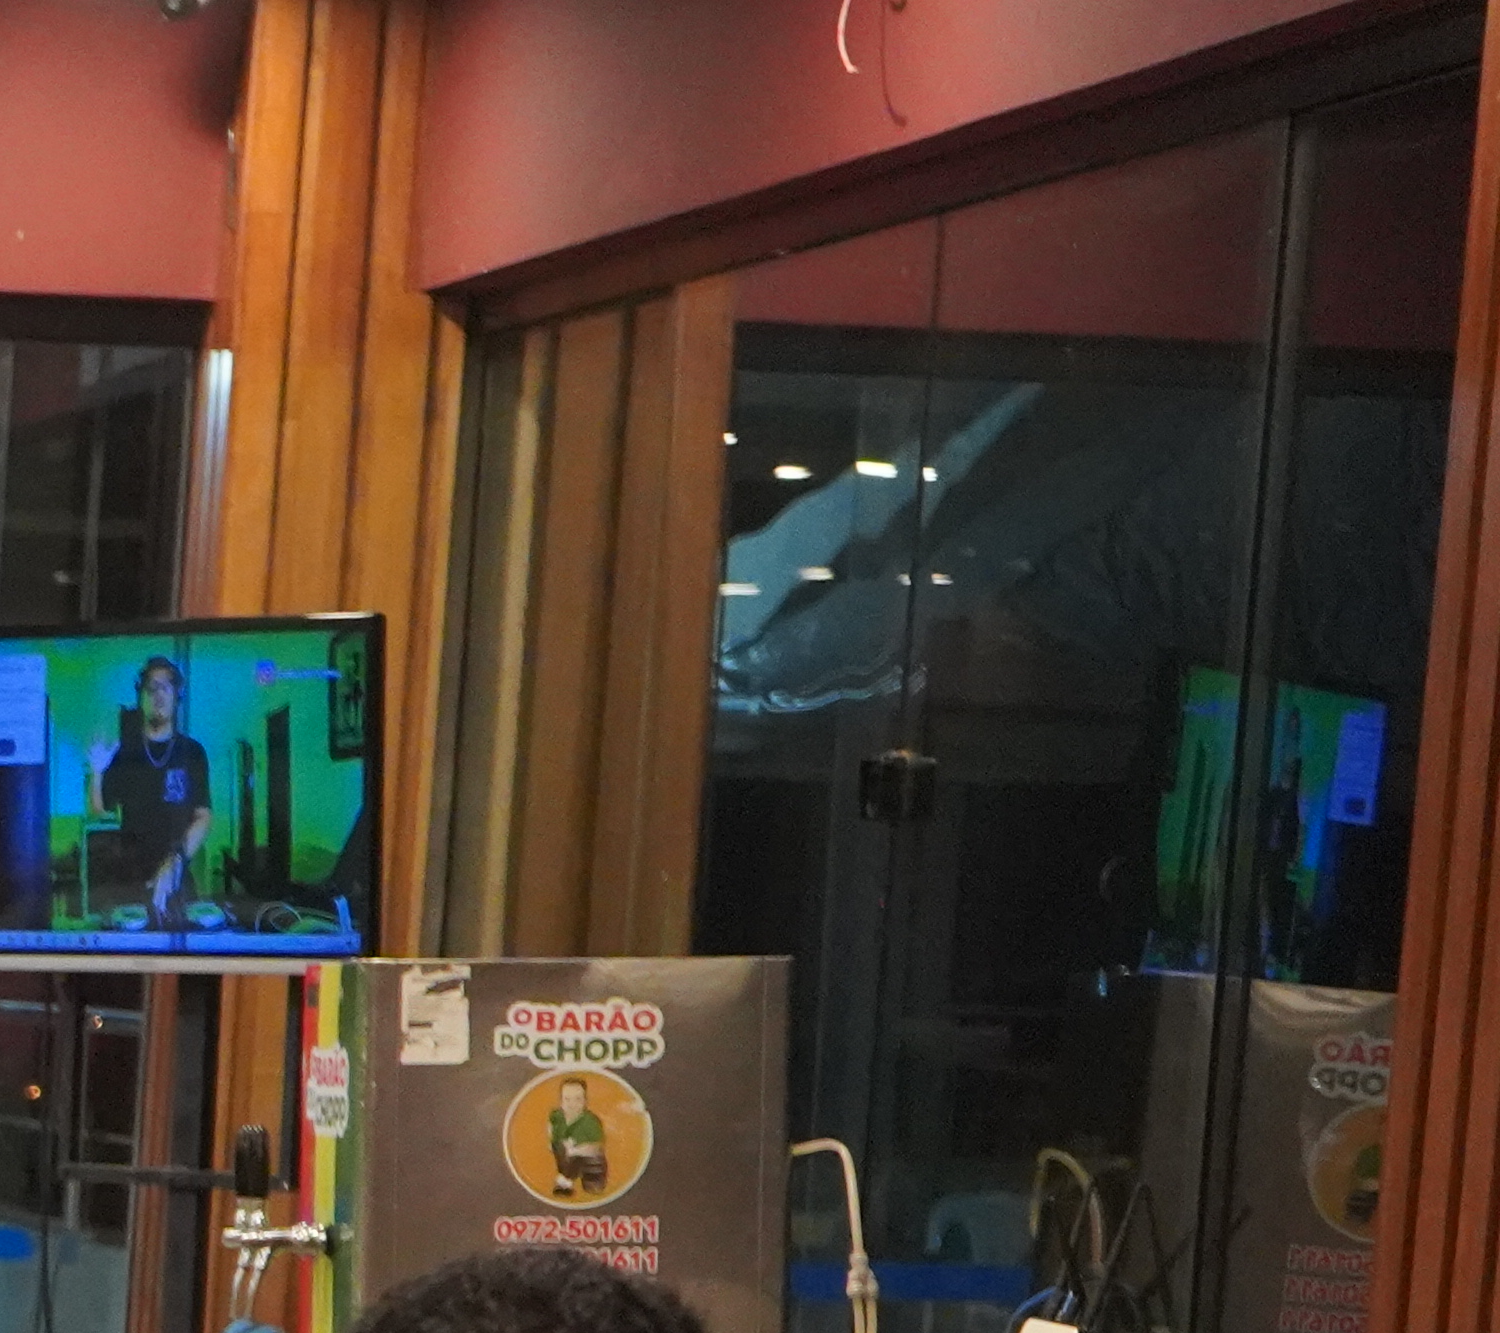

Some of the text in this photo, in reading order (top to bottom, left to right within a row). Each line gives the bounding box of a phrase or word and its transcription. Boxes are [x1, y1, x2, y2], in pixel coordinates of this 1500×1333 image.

[513, 1003, 658, 1033] O BARÃO
[500, 1032, 659, 1062] DO CHOPP
[496, 1219, 658, 1240] 0972-501611
